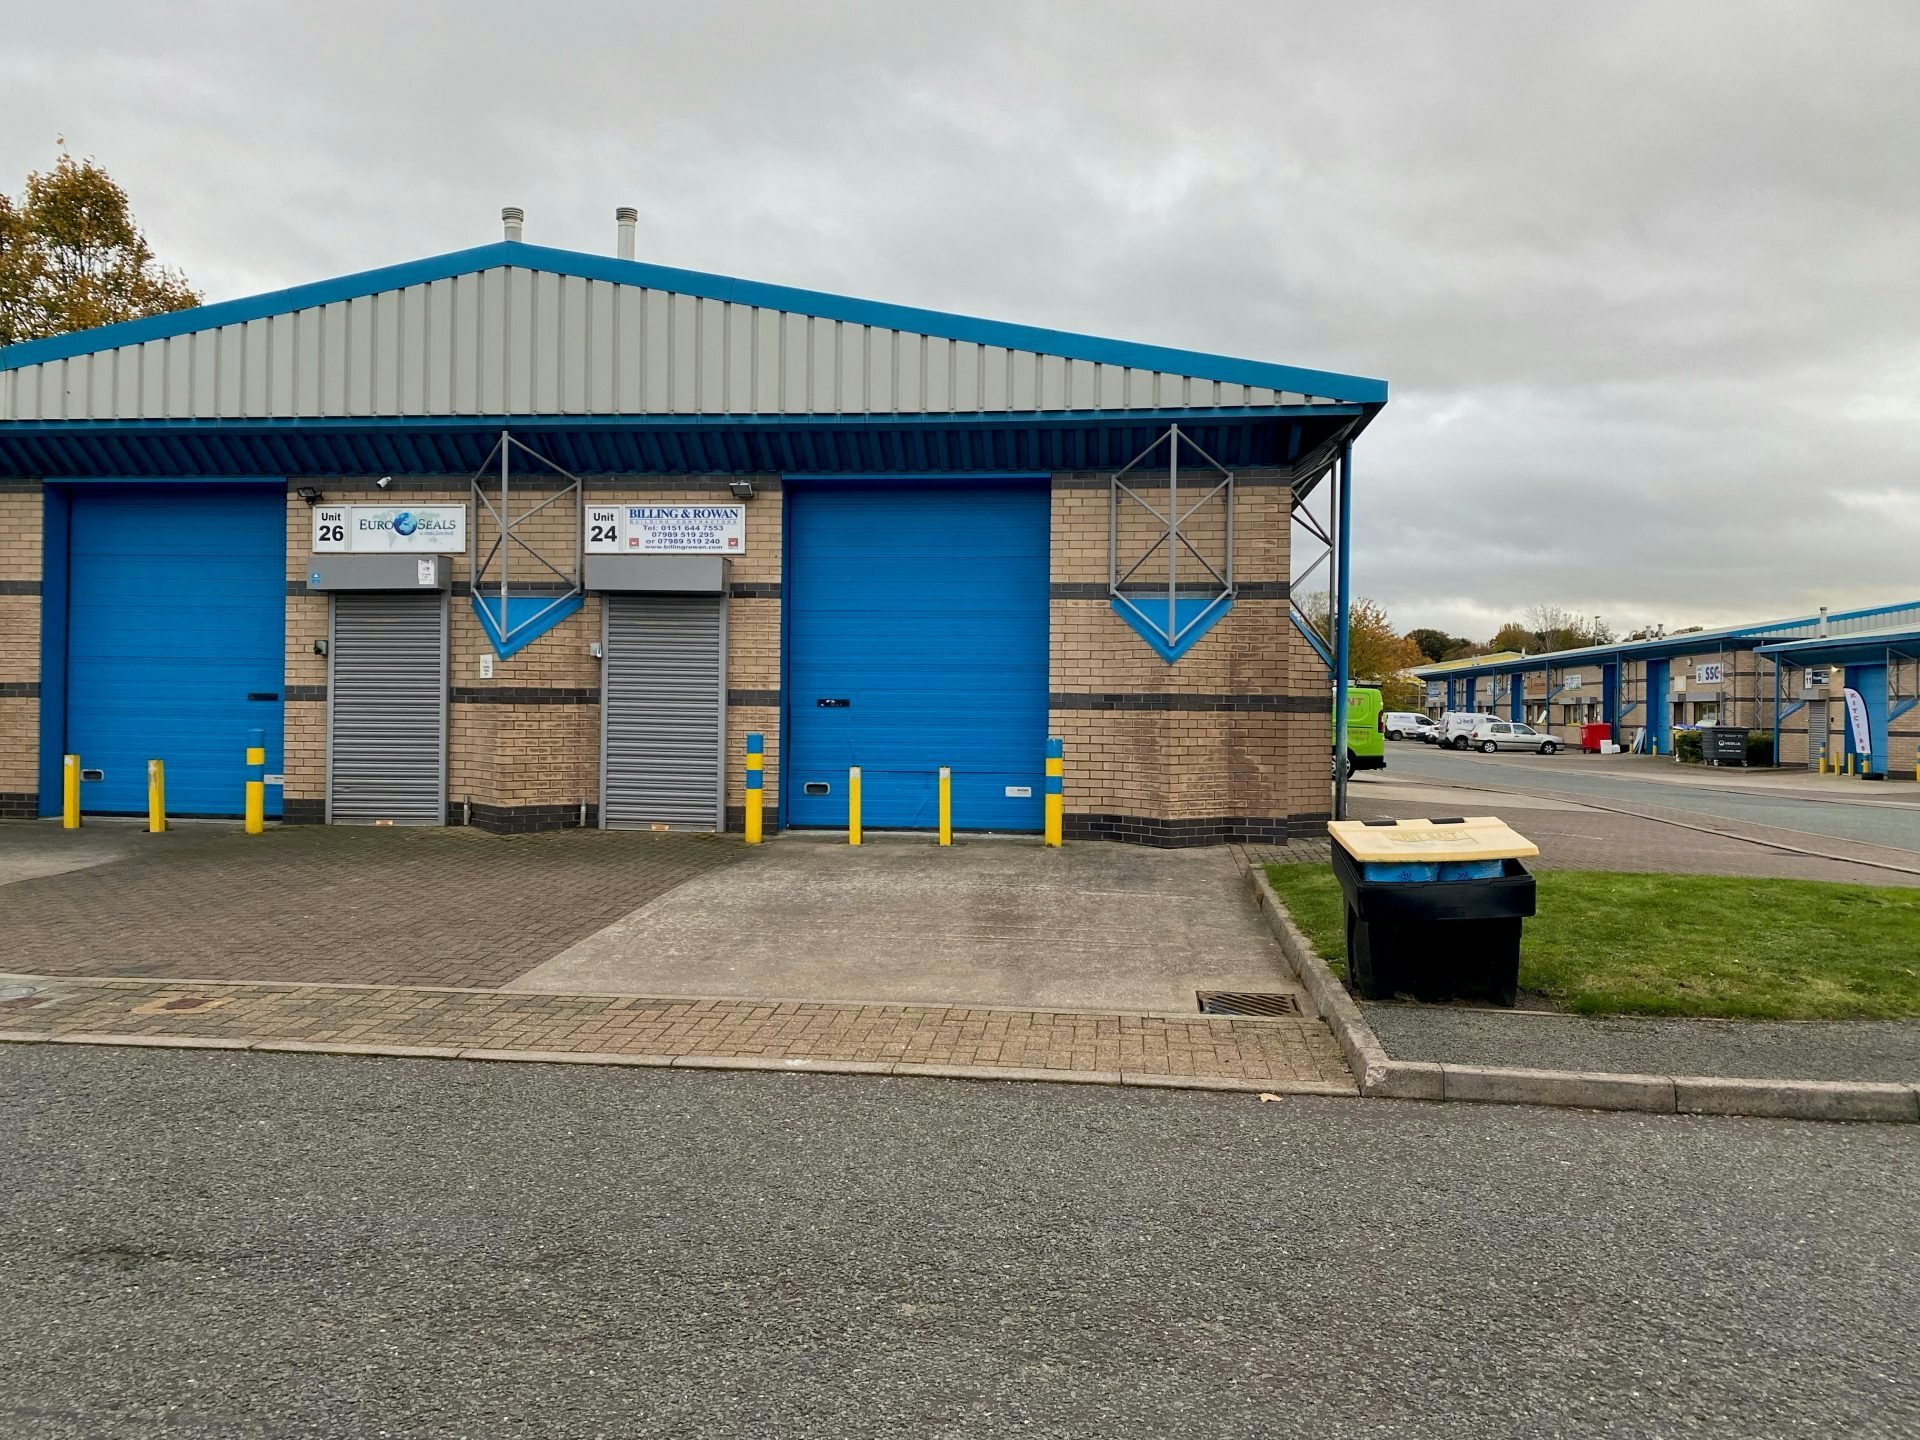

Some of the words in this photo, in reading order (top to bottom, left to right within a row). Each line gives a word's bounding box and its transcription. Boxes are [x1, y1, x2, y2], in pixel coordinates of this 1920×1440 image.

[321, 512, 341, 521] Unit
[593, 512, 614, 521] Unit
[629, 508, 678, 518] BILLING
[681, 509, 690, 518] &
[693, 508, 738, 518] ROWAN
[359, 518, 394, 530] EURO
[417, 518, 456, 530] SEALS
[318, 525, 344, 541] 26
[590, 525, 618, 542] 24
[1705, 666, 1719, 680] SSC
